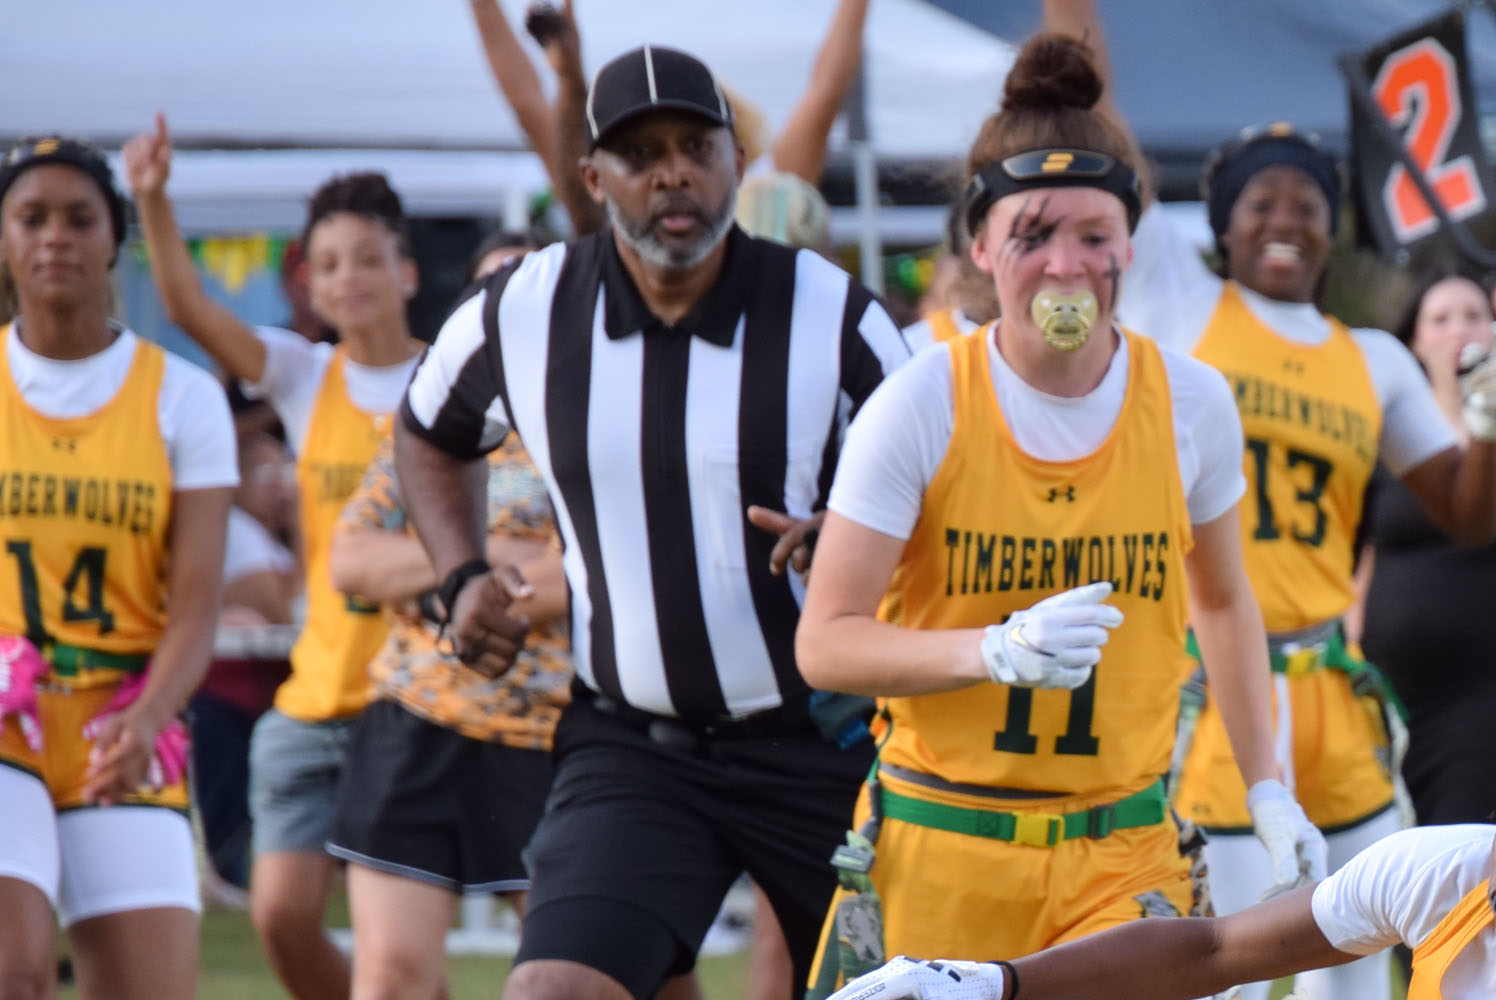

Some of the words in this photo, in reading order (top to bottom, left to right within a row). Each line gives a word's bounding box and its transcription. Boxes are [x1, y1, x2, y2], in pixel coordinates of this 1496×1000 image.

[1370, 36, 1487, 244] 2
[1247, 436, 1333, 547] 13
[5, 538, 115, 647] 14
[945, 527, 1169, 602] TIMBERWOLVES
[993, 614, 1100, 756] 11
